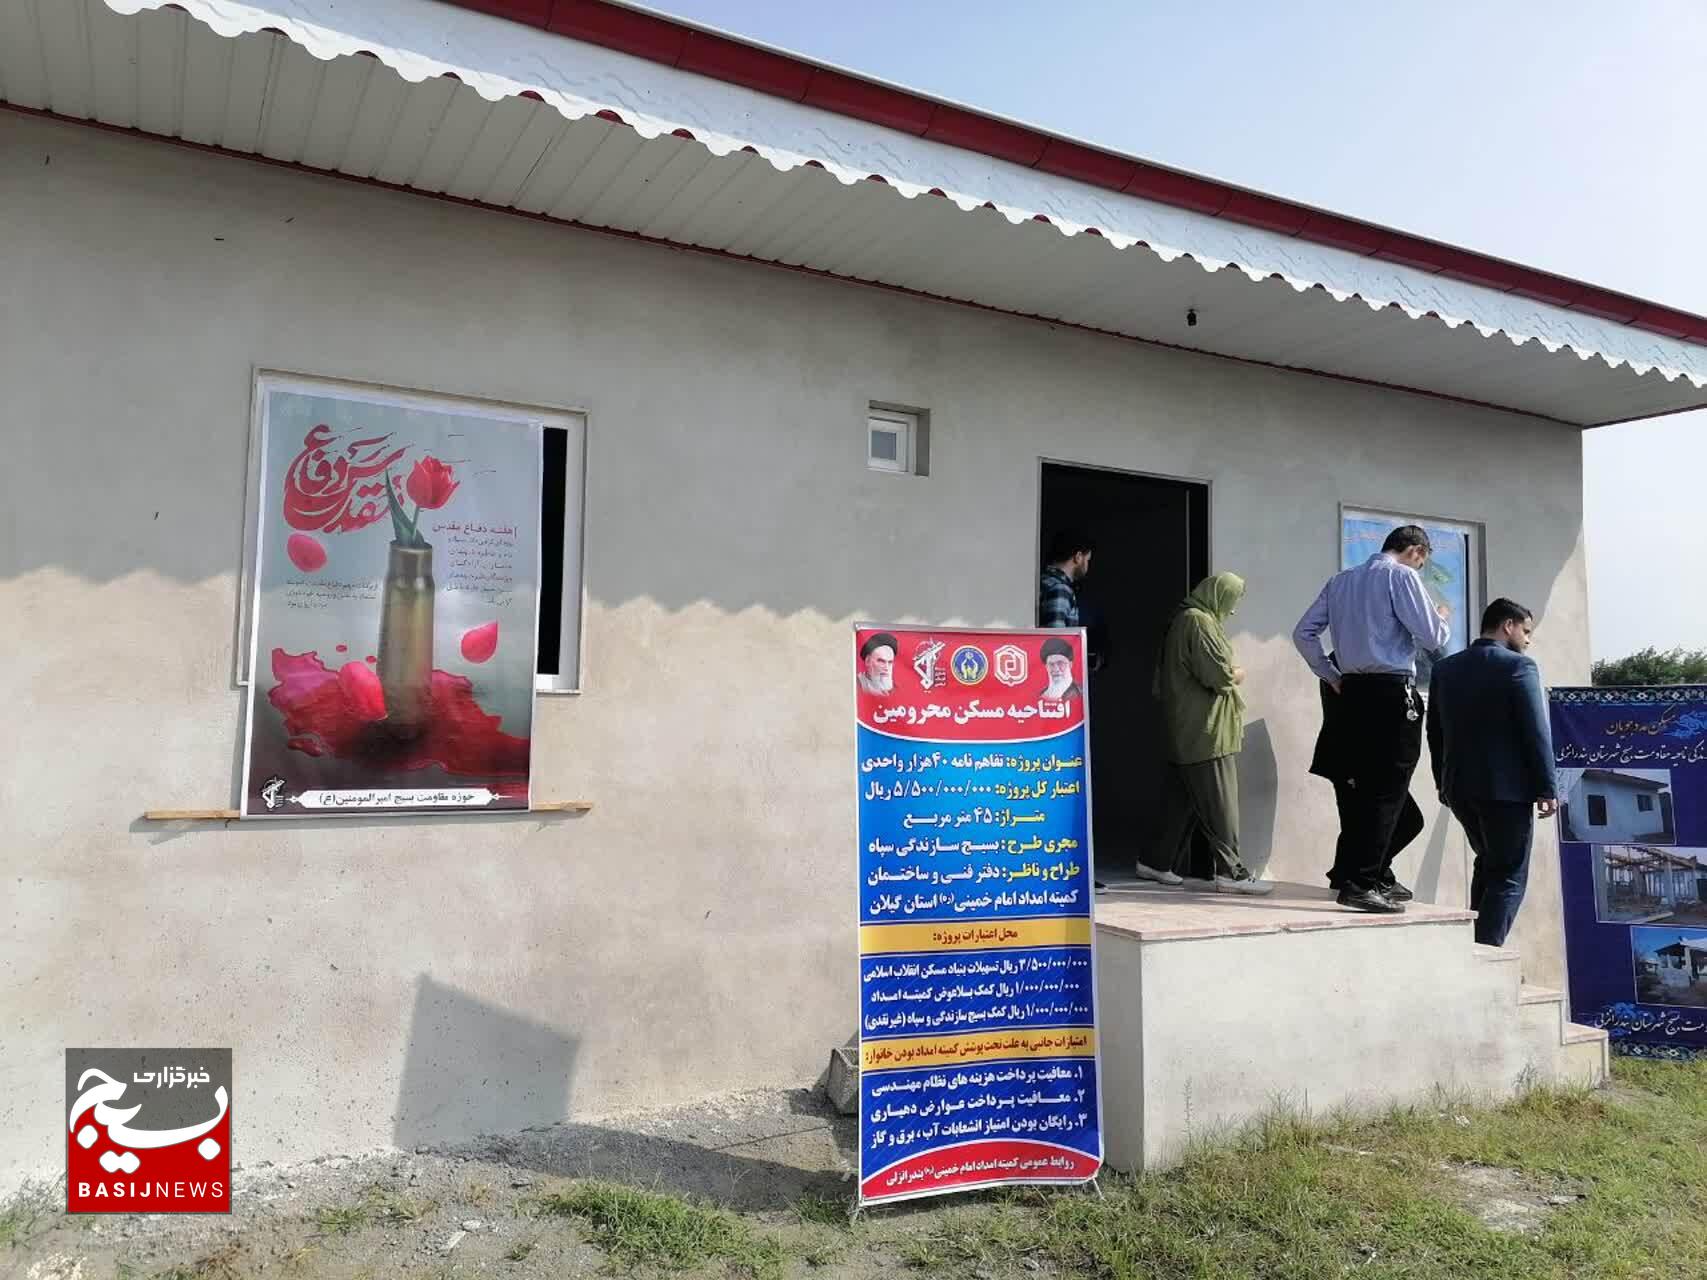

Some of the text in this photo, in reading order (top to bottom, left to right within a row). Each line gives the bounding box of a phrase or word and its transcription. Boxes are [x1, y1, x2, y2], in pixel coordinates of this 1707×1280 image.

[873, 699, 1070, 724] افتتاحیه مسکن محرومین
[951, 753, 973, 767] نامه
[1589, 743, 1620, 762] شهرستان
[860, 754, 904, 772] واحدی
[974, 754, 1005, 773] تفاهم
[1042, 754, 1083, 770] عنوان
[1031, 780, 1048, 798] کل
[1051, 780, 1080, 799] اعتبار
[394, 794, 414, 804] بسیج
[417, 793, 448, 803] مقاومت
[452, 793, 474, 802] حوزه
[903, 812, 952, 829] مربع
[954, 810, 972, 828] متر
[974, 806, 992, 824] ۴۵
[868, 838, 895, 857] سپاه
[896, 837, 960, 857] سازندگی
[961, 838, 1000, 855] بسیج
[1044, 837, 1079, 853] مجری
[867, 866, 929, 885] ساختمان
[930, 871, 938, 884] و
[941, 864, 973, 883] فنی
[976, 865, 1000, 883] دفتر
[1042, 870, 1049, 880] و
[1050, 862, 1080, 880] طراح
[870, 894, 902, 914] گیلان
[904, 894, 938, 913] استان
[994, 891, 1017, 910] امام
[1018, 890, 1048, 904] امداد
[1049, 889, 1079, 905] کمیته
[962, 928, 998, 943] اعتبارات
[999, 928, 1018, 942] محل
[863, 965, 893, 982] اسلامی
[893, 964, 920, 980] انقلاب
[920, 964, 947, 979] مسکن
[948, 962, 966, 977] بنیاد
[967, 961, 999, 976] تسهیلات
[1000, 960, 1018, 974] ریال
[871, 988, 901, 1002] امداد
[902, 986, 933, 1002] کمیته
[974, 983, 995, 996] کمک
[996, 982, 1014, 997] ریال
[932, 1009, 967, 1026] سازندگی
[968, 1010, 986, 1023] بسیج
[987, 1005, 1007, 1018] کمک
[1007, 1005, 1025, 1019] ریال
[907, 1012, 925, 1028] سپاه
[894, 1048, 914, 1061] بودن
[916, 1044, 937, 1056] امداد
[938, 1043, 959, 1057] کمیته
[996, 1067, 1036, 1083] پرداخت
[1037, 1066, 1072, 1082] معافیت
[871, 1079, 921, 1096] مهندسی
[922, 1074, 947, 1092] نظام
[967, 1092, 1015, 1109] پرداخت
[1017, 1090, 1071, 1107] معافیت
[870, 1103, 917, 1123] دهیاری
[920, 1098, 965, 1116] عوارض
[941, 1118, 982, 1138] انشعابات
[983, 1116, 1010, 1135] امتیاز
[1011, 1117, 1037, 1132] بودن
[1039, 1114, 1073, 1131] رایگان
[871, 1129, 888, 1149] گاز
[888, 1134, 895, 1146] و
[896, 1130, 915, 1145] برق
[960, 1160, 975, 1174] امام
[976, 1159, 997, 1170] امداد
[997, 1157, 1019, 1169] کمیته
[1020, 1157, 1049, 1170] عمومی
[1050, 1155, 1075, 1170] روابط
